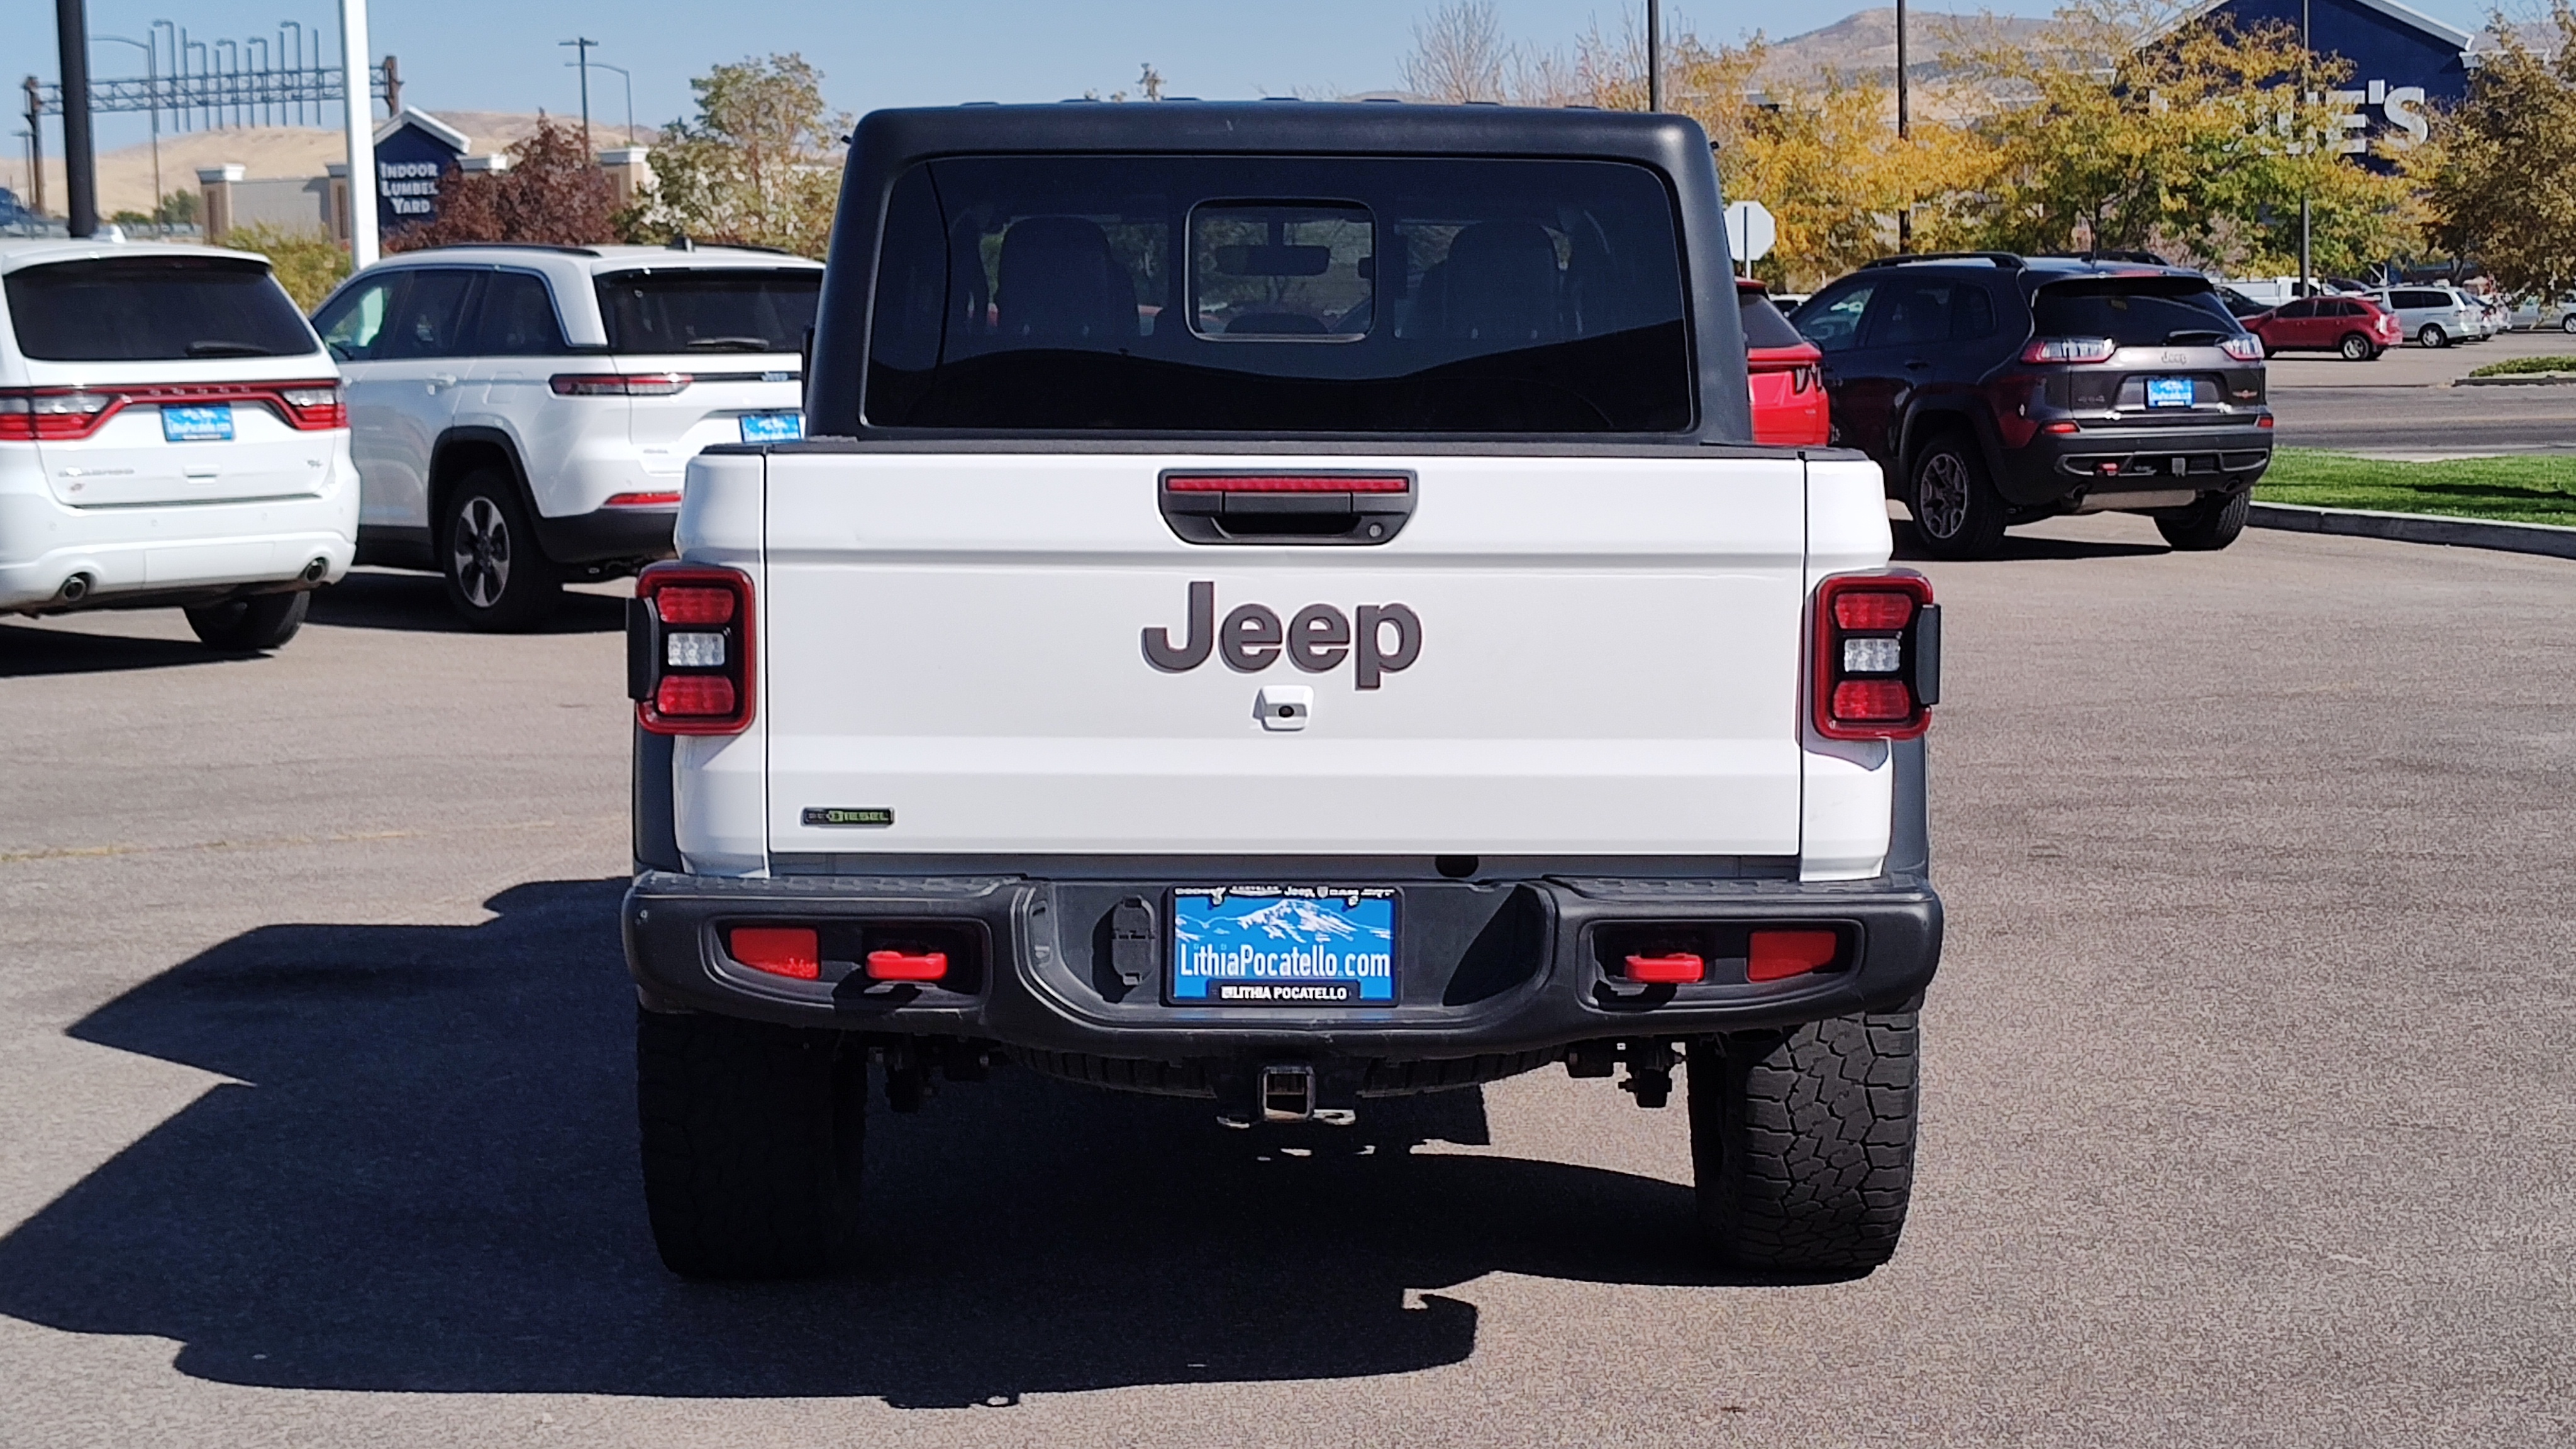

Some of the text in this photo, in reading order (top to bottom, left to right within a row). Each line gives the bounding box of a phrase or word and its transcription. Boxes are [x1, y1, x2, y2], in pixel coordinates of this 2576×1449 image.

[380, 162, 438, 178] INDOOR
[391, 197, 430, 214] YARD
[1141, 581, 1423, 691] Jeep
[1180, 943, 1391, 977] LithiaPocatello.com
[1235, 987, 1347, 1000] LITHIA POCATELLO
